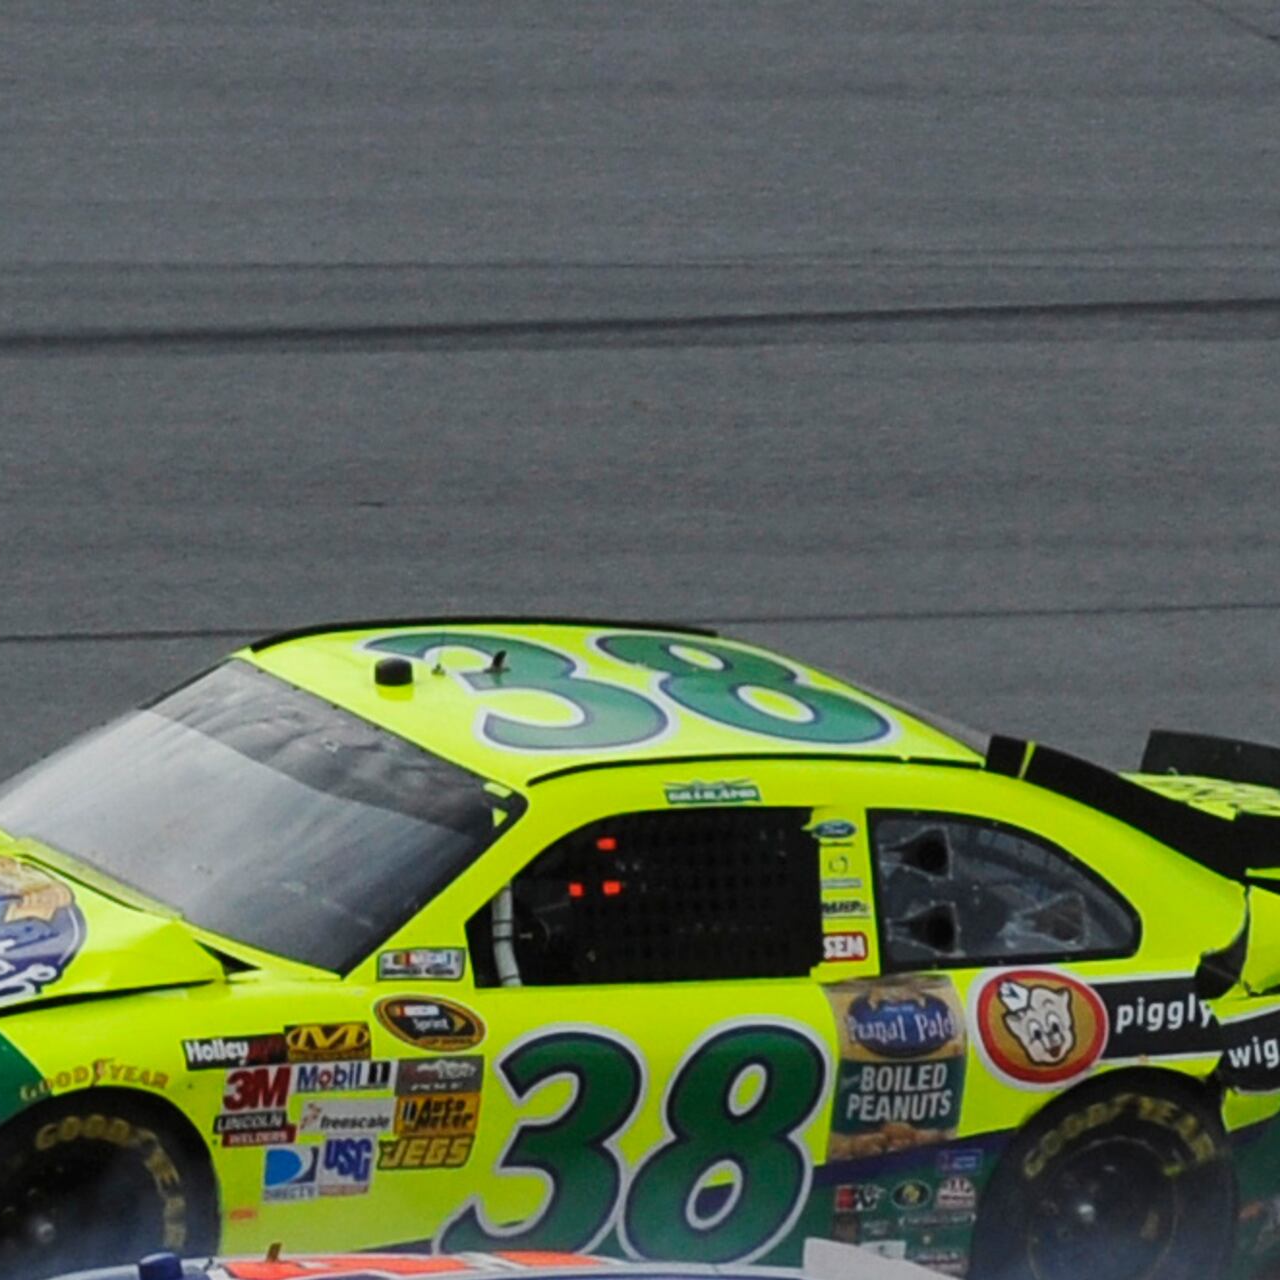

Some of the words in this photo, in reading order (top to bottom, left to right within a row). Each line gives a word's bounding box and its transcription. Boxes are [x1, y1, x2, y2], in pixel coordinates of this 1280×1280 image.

[354, 628, 902, 751] 38
[823, 934, 866, 959] SEM
[1115, 992, 1215, 1033] piggly
[184, 1039, 251, 1067] Holley
[21, 1058, 170, 1101] GOODYEAR
[222, 1066, 292, 1111] 3M
[297, 1063, 363, 1093] Mobil
[859, 1062, 948, 1093] BOILED
[320, 1109, 390, 1130] freescale
[423, 1101, 466, 1116] Auto
[846, 1090, 953, 1122] PEANUTS
[217, 1115, 284, 1132] LINCOLN
[380, 1136, 470, 1169] JEGS
[431, 1014, 832, 1266] 38
[324, 1138, 373, 1183] USG
